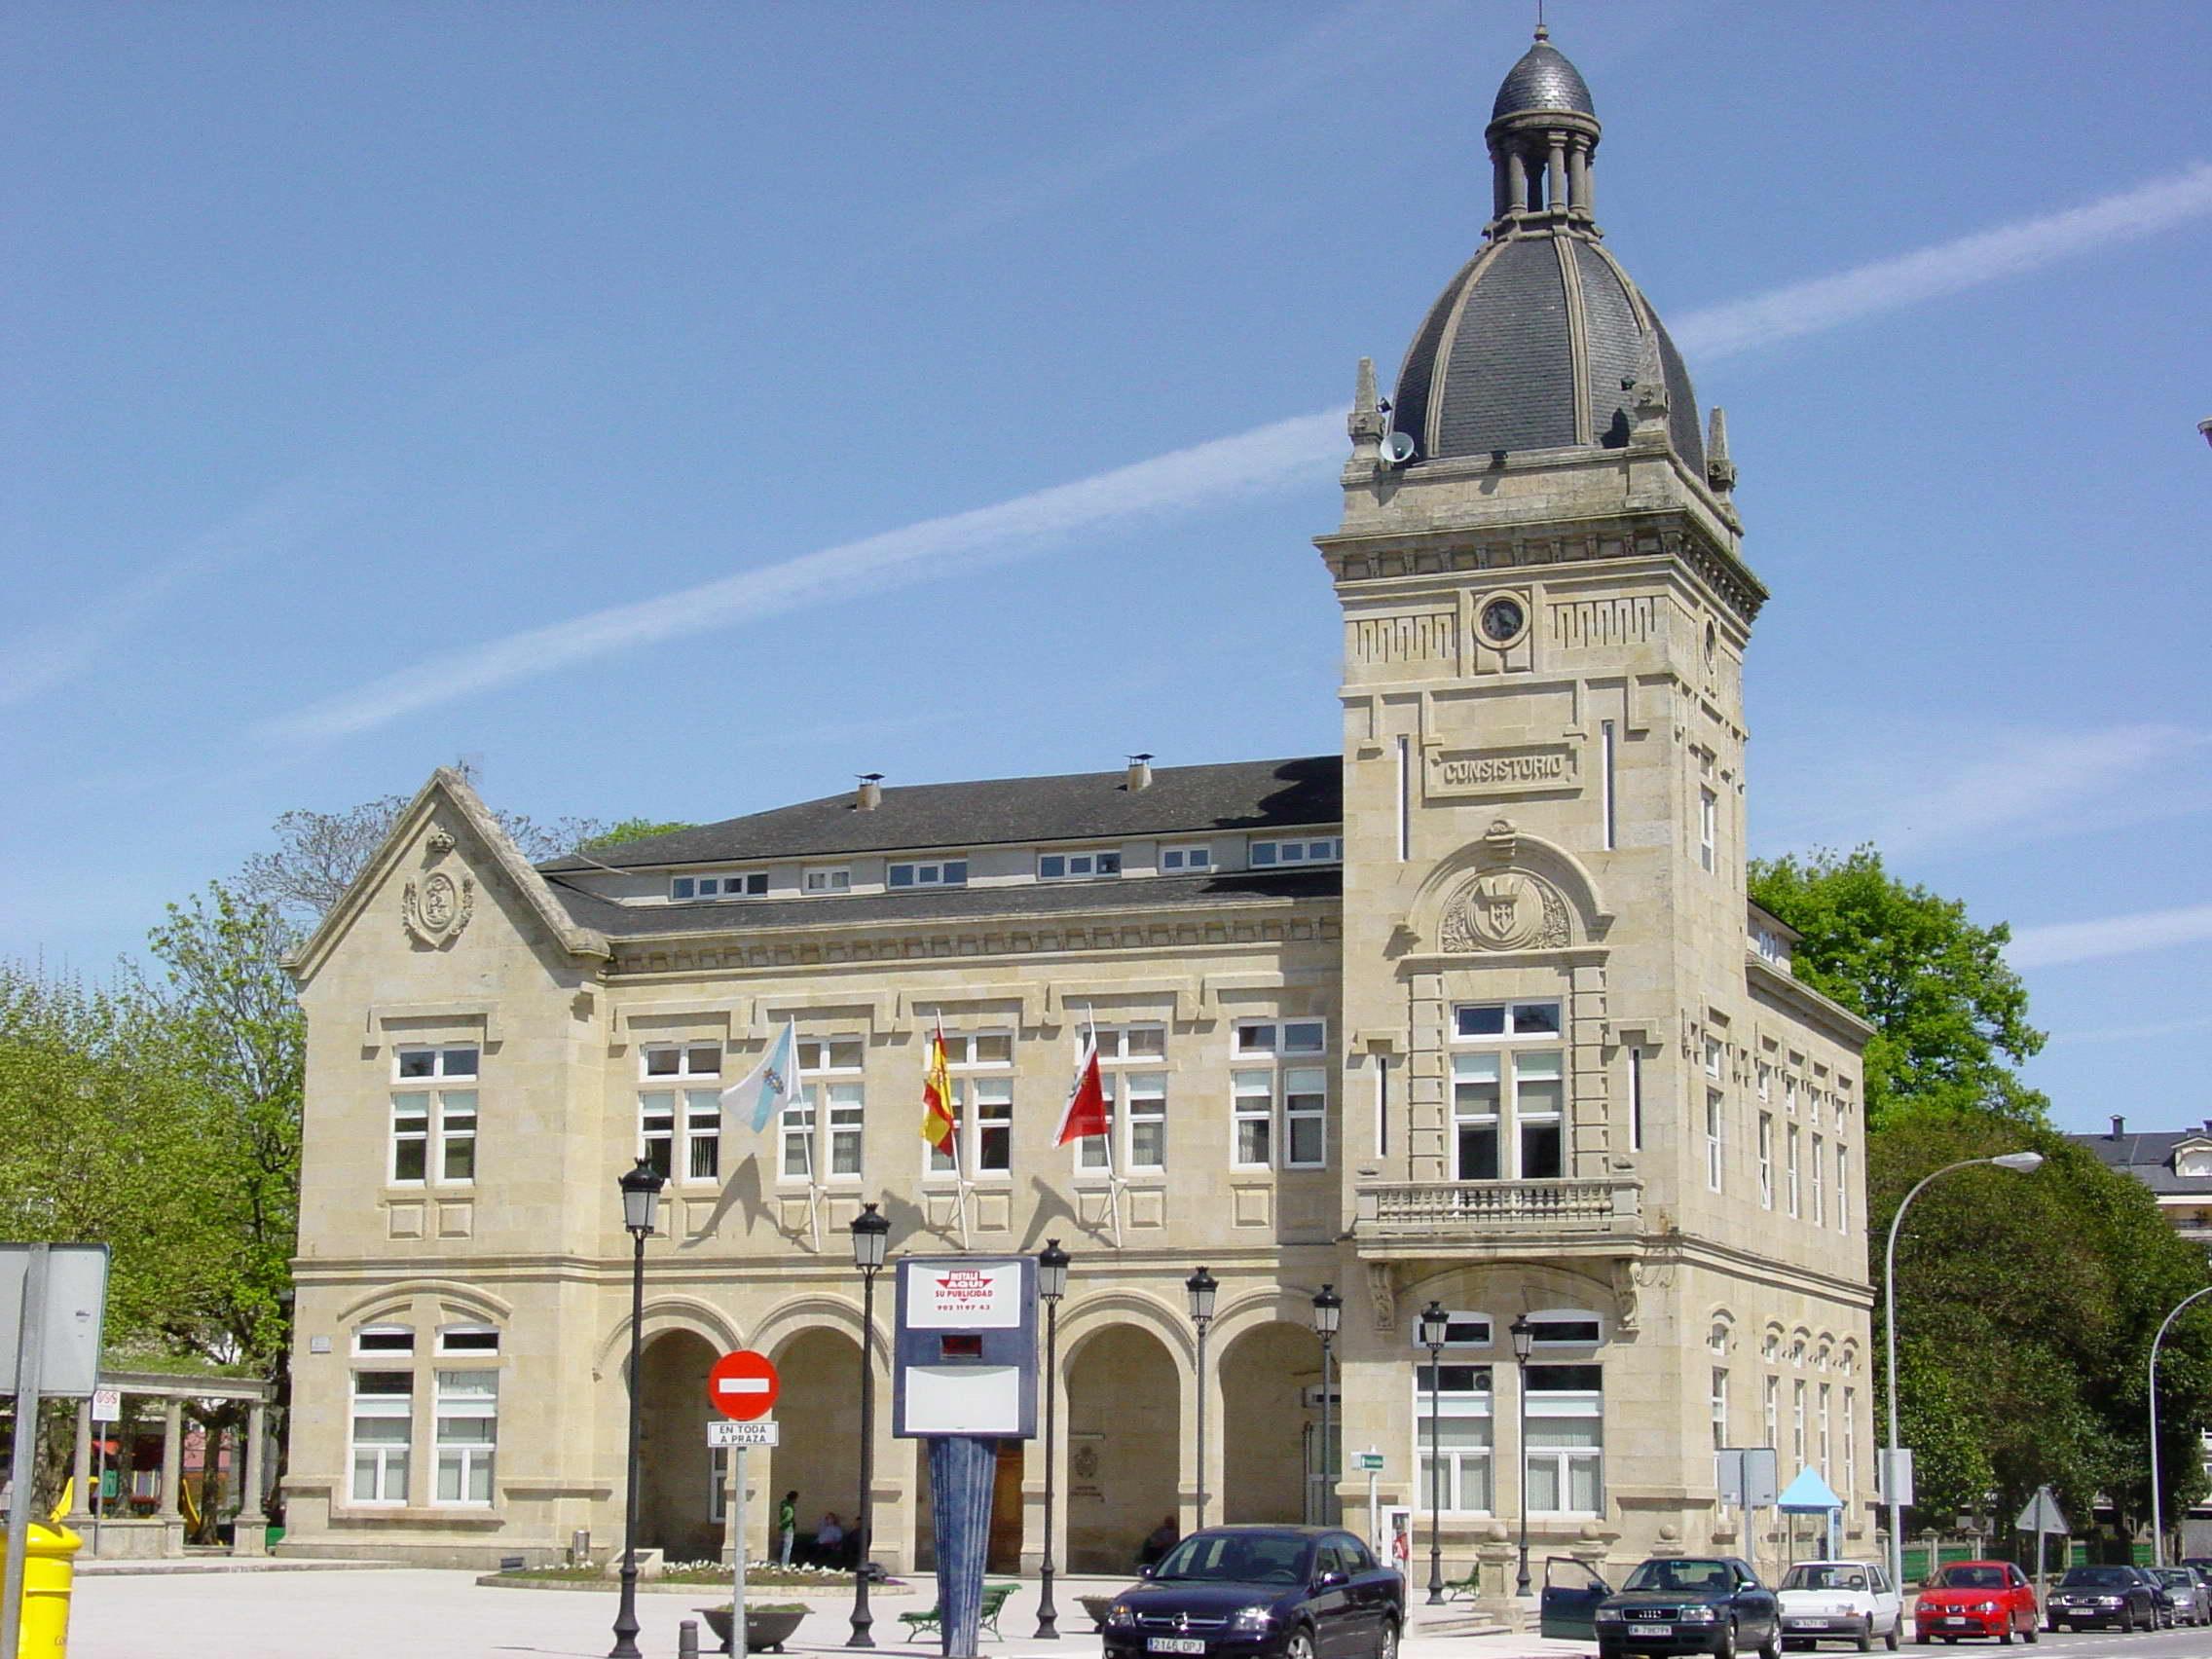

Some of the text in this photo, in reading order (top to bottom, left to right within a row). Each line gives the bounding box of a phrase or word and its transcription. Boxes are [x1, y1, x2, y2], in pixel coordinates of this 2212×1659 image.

[1444, 754, 1564, 784] CONSISTORIO
[719, 1425, 766, 1434] EN TODA
[731, 1434, 766, 1443] PRAZA
[1154, 1639, 1178, 1651] 2146
